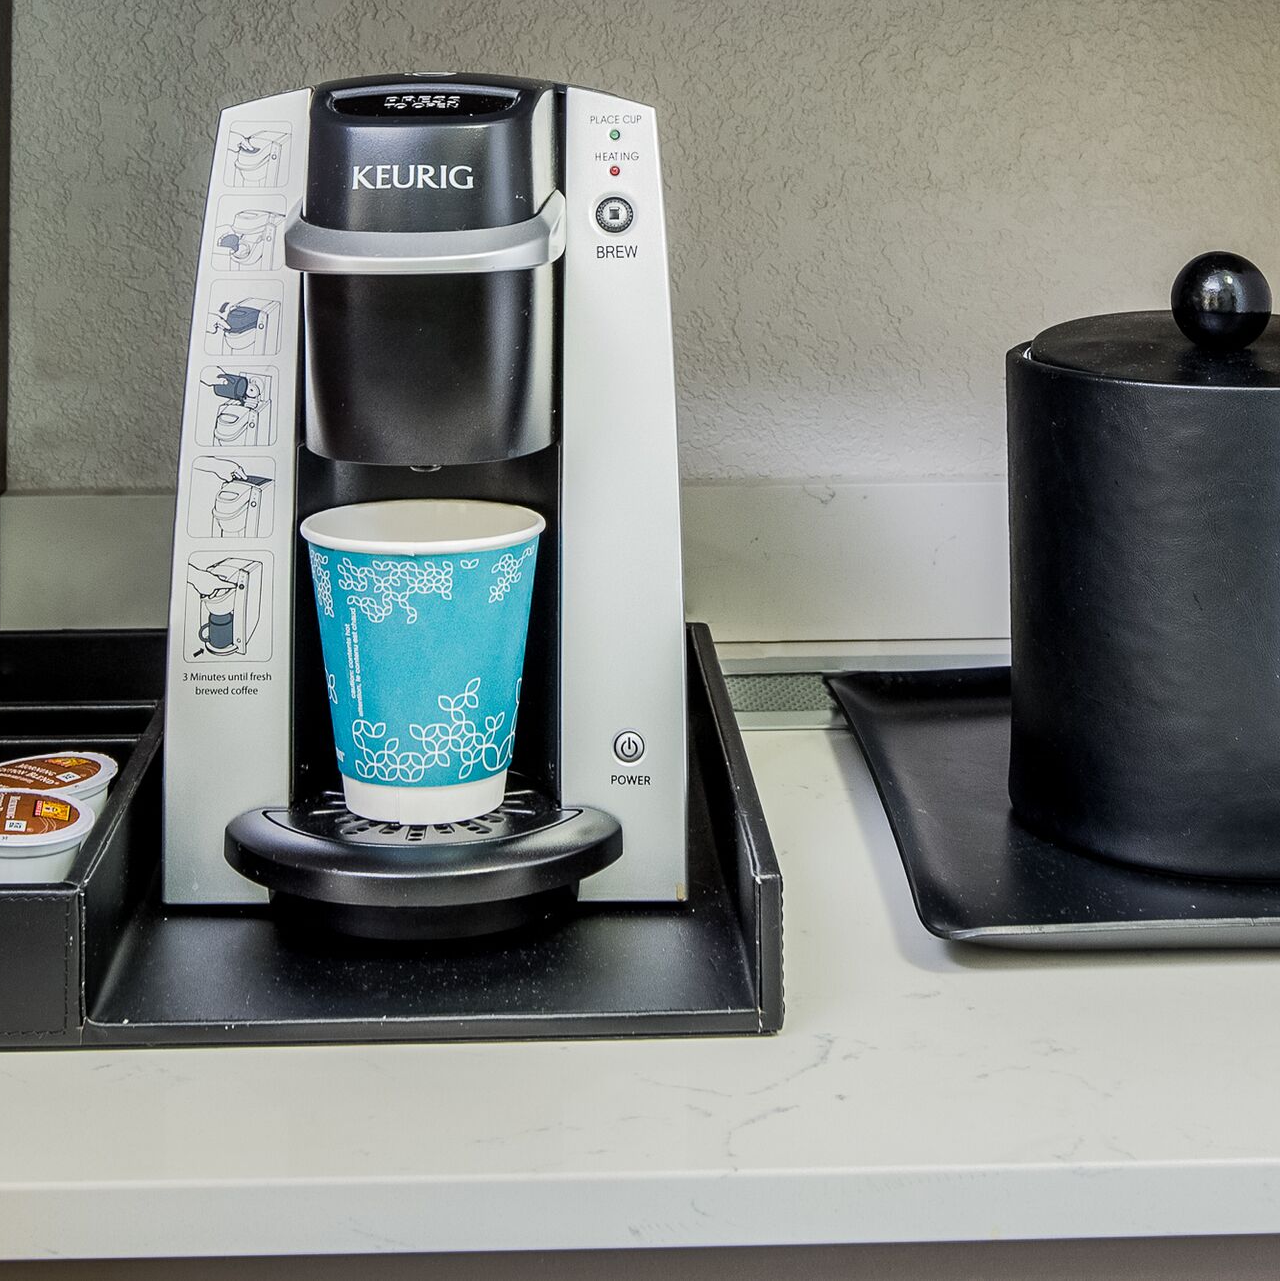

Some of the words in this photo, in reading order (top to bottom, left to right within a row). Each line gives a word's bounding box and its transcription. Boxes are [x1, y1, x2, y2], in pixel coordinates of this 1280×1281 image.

[589, 115, 620, 125] PLACE
[622, 115, 642, 124] CUP
[594, 151, 640, 161] HEATING
[351, 164, 475, 191] KEURIG
[596, 245, 638, 259] BREW
[182, 672, 188, 681] 3
[190, 672, 226, 681] Minutes
[227, 672, 248, 681] until
[249, 672, 272, 681] fresh
[195, 686, 229, 695] brewed
[230, 685, 259, 695] coffee
[610, 775, 651, 785] POWER
